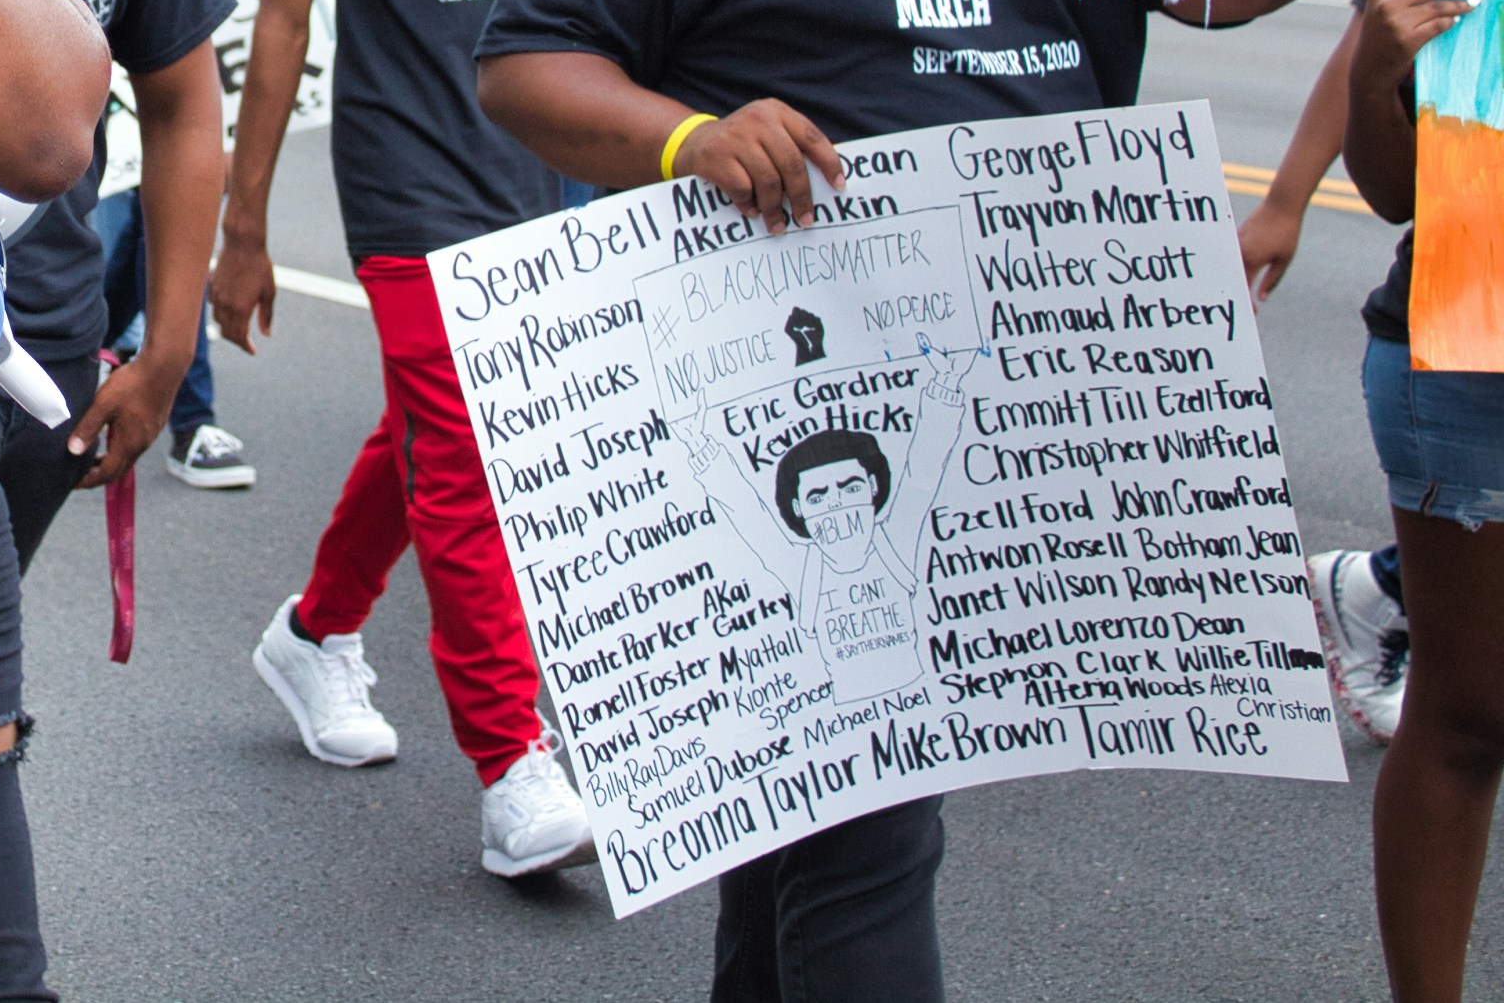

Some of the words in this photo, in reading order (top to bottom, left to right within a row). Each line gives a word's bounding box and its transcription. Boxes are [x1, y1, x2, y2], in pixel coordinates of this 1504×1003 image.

[913, 46, 1022, 76] SEPTEMBER
[948, 126, 1076, 193] George
[1076, 110, 1195, 186] Floyd
[959, 190, 1089, 246] Trayvon
[1094, 185, 1218, 226] Martin
[453, 248, 564, 321] Sean
[560, 201, 661, 272] Bell
[976, 239, 1097, 293] Walter
[1104, 238, 1196, 285] Scott
[703, 328, 776, 383] JUSTICE
[897, 291, 955, 328] PEACE
[991, 299, 1114, 340] Ahmaud
[1123, 294, 1234, 341] Arbery
[998, 346, 1077, 381] Eric
[1082, 344, 1214, 375] Reason
[479, 392, 560, 449] Kevin
[723, 397, 786, 437] Eric
[793, 367, 920, 409] Gardner
[972, 391, 1091, 436] Emmitt
[1088, 385, 1148, 424] Till
[1156, 385, 1210, 416] Ezell
[1209, 376, 1273, 411] Ford
[488, 443, 570, 505] David
[570, 409, 670, 471] Joseph
[743, 414, 819, 472] Kevin
[963, 438, 1149, 486] Christopher
[1157, 425, 1281, 463] Whitfield
[504, 504, 588, 552] Philip
[588, 468, 668, 518] White
[814, 510, 864, 544] #BLM
[931, 499, 1018, 541] Ezell
[1020, 489, 1094, 523] Ford
[1111, 480, 1173, 522] John
[1172, 475, 1293, 515] Crawford
[517, 550, 608, 616] Tyree
[606, 496, 716, 567] Crawford
[926, 544, 1042, 584] Antwon
[1134, 527, 1242, 561] Botham
[1245, 524, 1302, 559] Jean
[537, 592, 629, 658] Michael
[627, 561, 714, 614] Brown
[713, 593, 794, 637] Gurley
[820, 589, 842, 613] I
[826, 602, 904, 645] BREATHE
[927, 583, 1009, 625] Janet
[1014, 569, 1118, 608] Wilson
[1122, 566, 1207, 603] Randy
[1207, 568, 1312, 601] Nelson
[547, 648, 622, 694] Dante
[929, 623, 1052, 673] Michael
[1055, 615, 1170, 646] Lorenzo
[1171, 612, 1245, 642] Dean
[940, 661, 1068, 704] Stephon
[1175, 645, 1251, 673] Willie
[1124, 675, 1205, 698] Woods
[1210, 673, 1272, 696] Alexia
[576, 720, 640, 774] David
[639, 689, 730, 740] Joseph
[760, 680, 834, 731] Spencer
[1237, 697, 1331, 723] Christian
[628, 770, 705, 829] Samuel
[704, 735, 793, 793] Dubose
[804, 701, 880, 749] Michael
[883, 687, 931, 716] Noel
[607, 797, 757, 896] Breonna
[742, 753, 860, 830] Taylor
[941, 712, 1067, 761] Brown
[1058, 702, 1176, 759] Tamir
[1186, 706, 1267, 756] Rice
